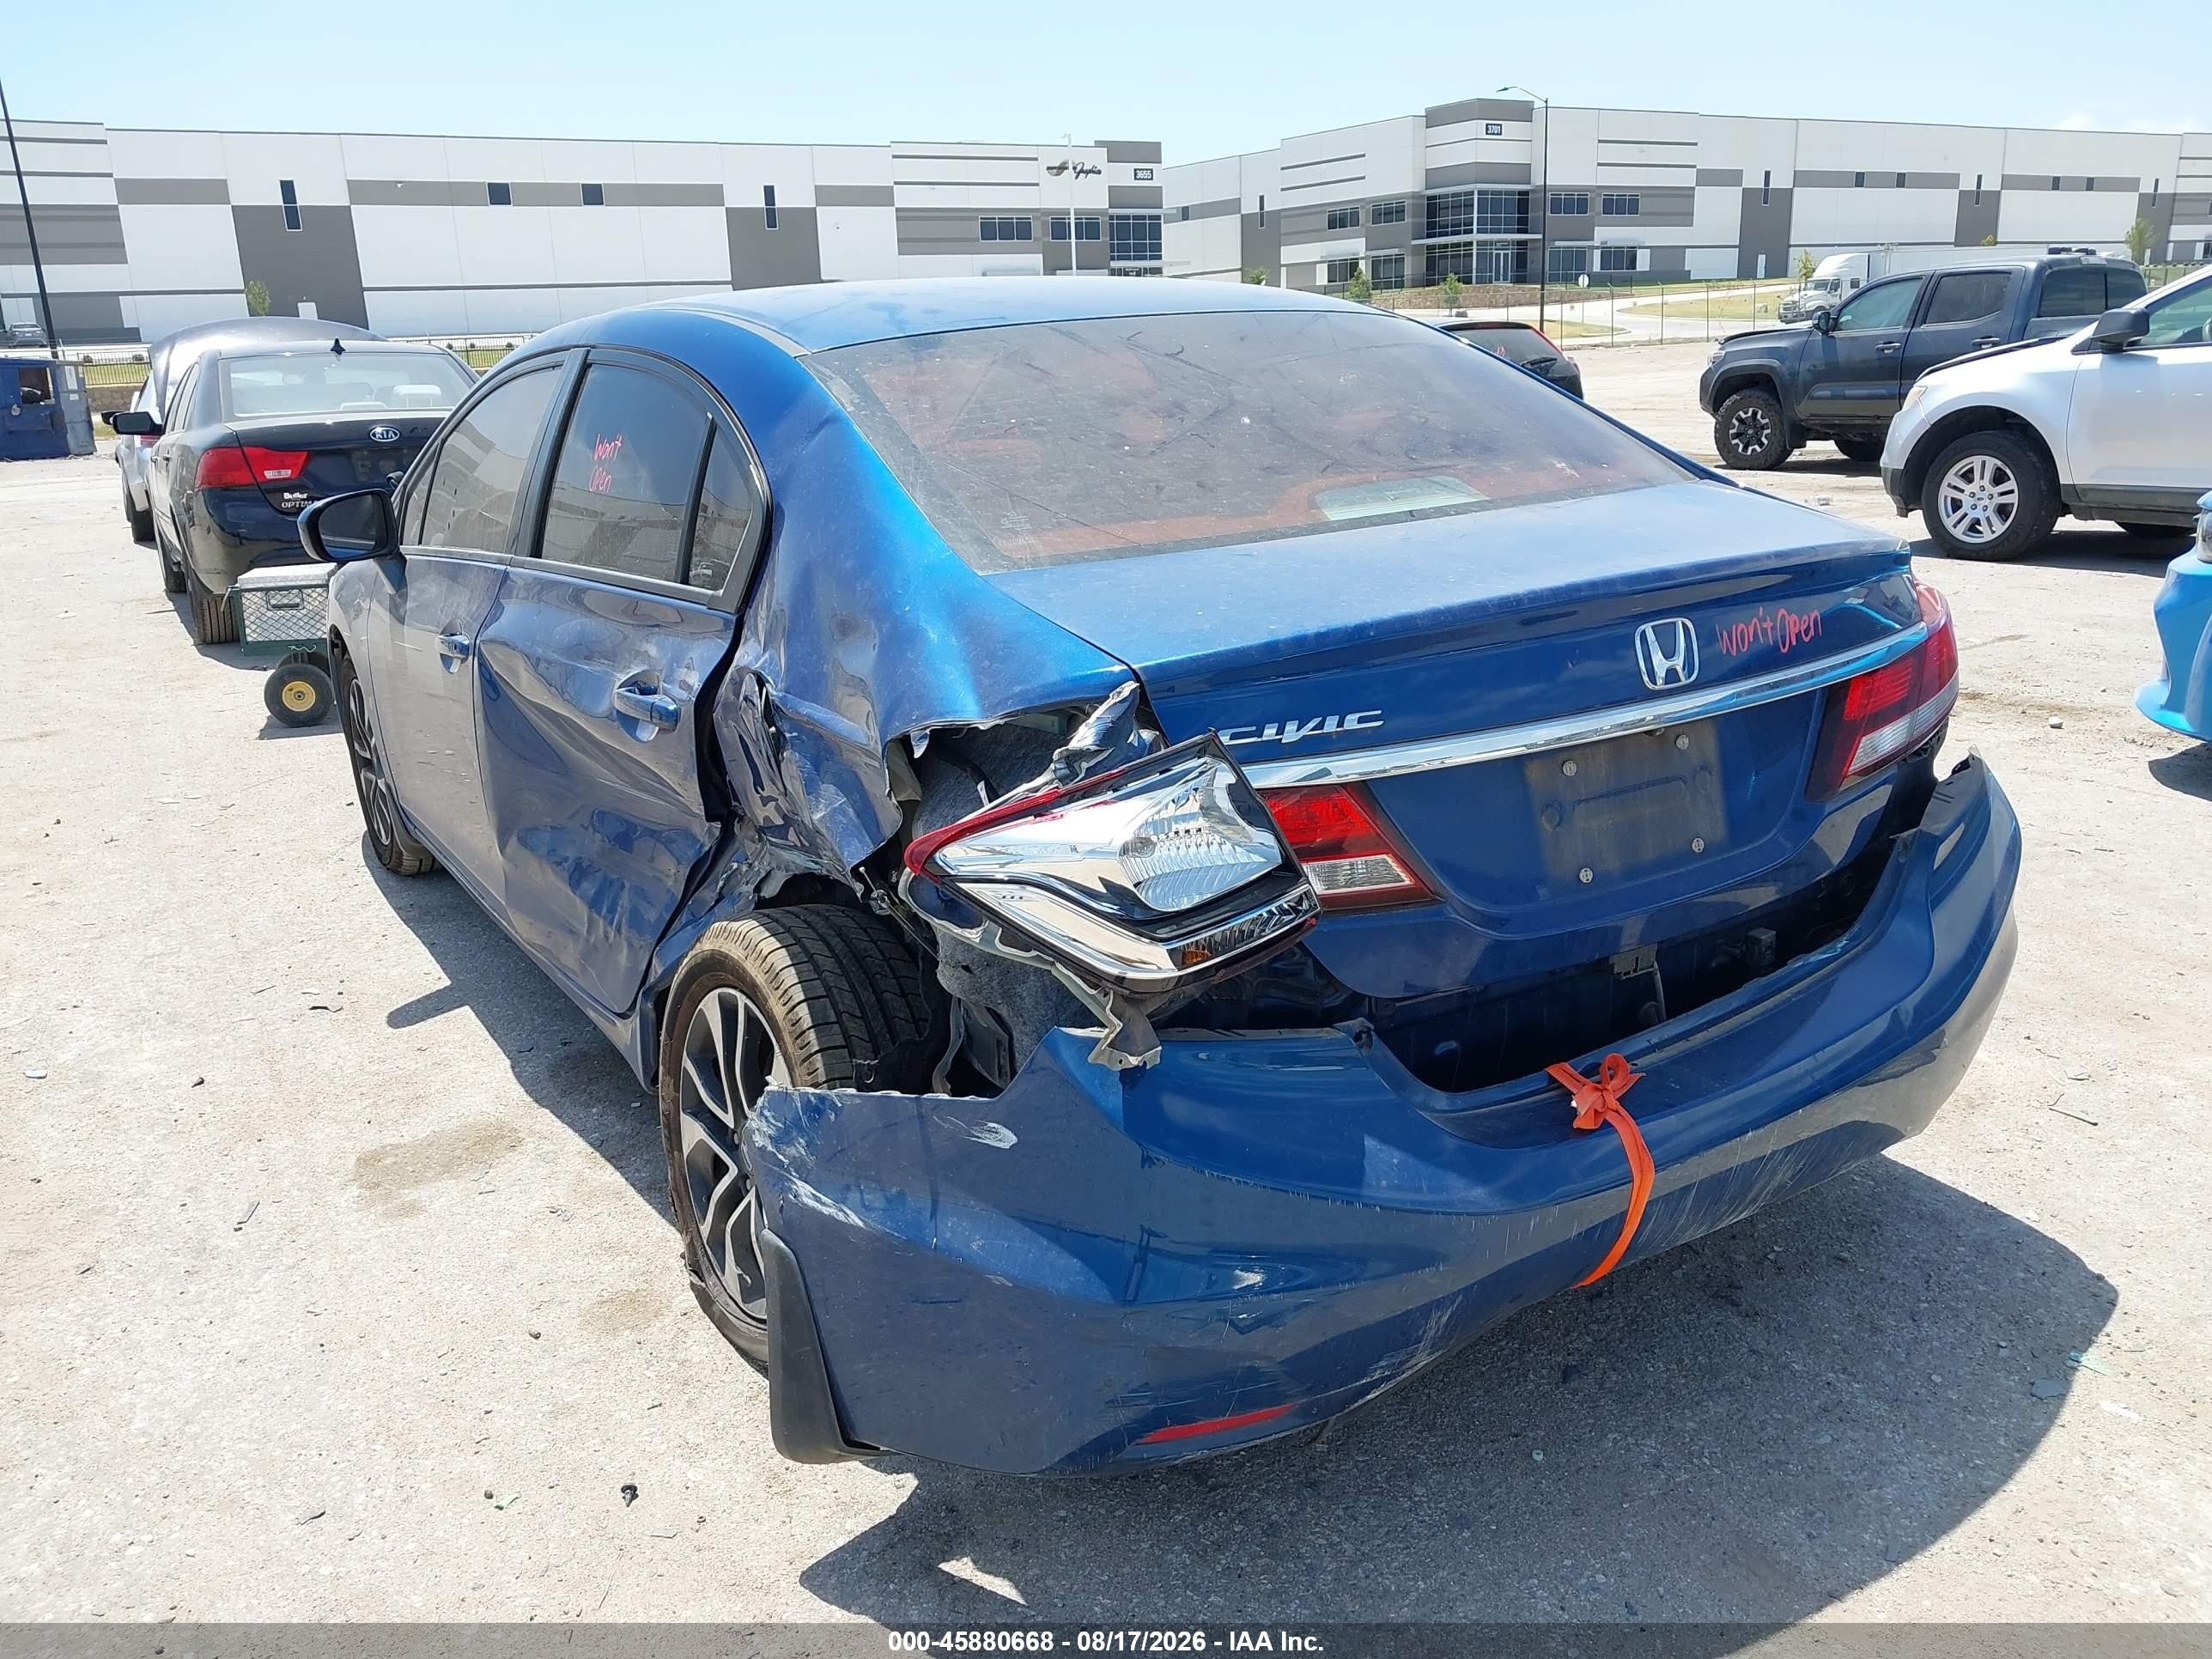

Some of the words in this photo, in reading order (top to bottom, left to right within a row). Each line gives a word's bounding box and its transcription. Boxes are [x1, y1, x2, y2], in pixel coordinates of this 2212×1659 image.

[1486, 125, 1501, 134] 3701
[1135, 170, 1152, 179] 3655
[374, 428, 396, 439] KIA
[1218, 710, 1384, 745] CIVIC
